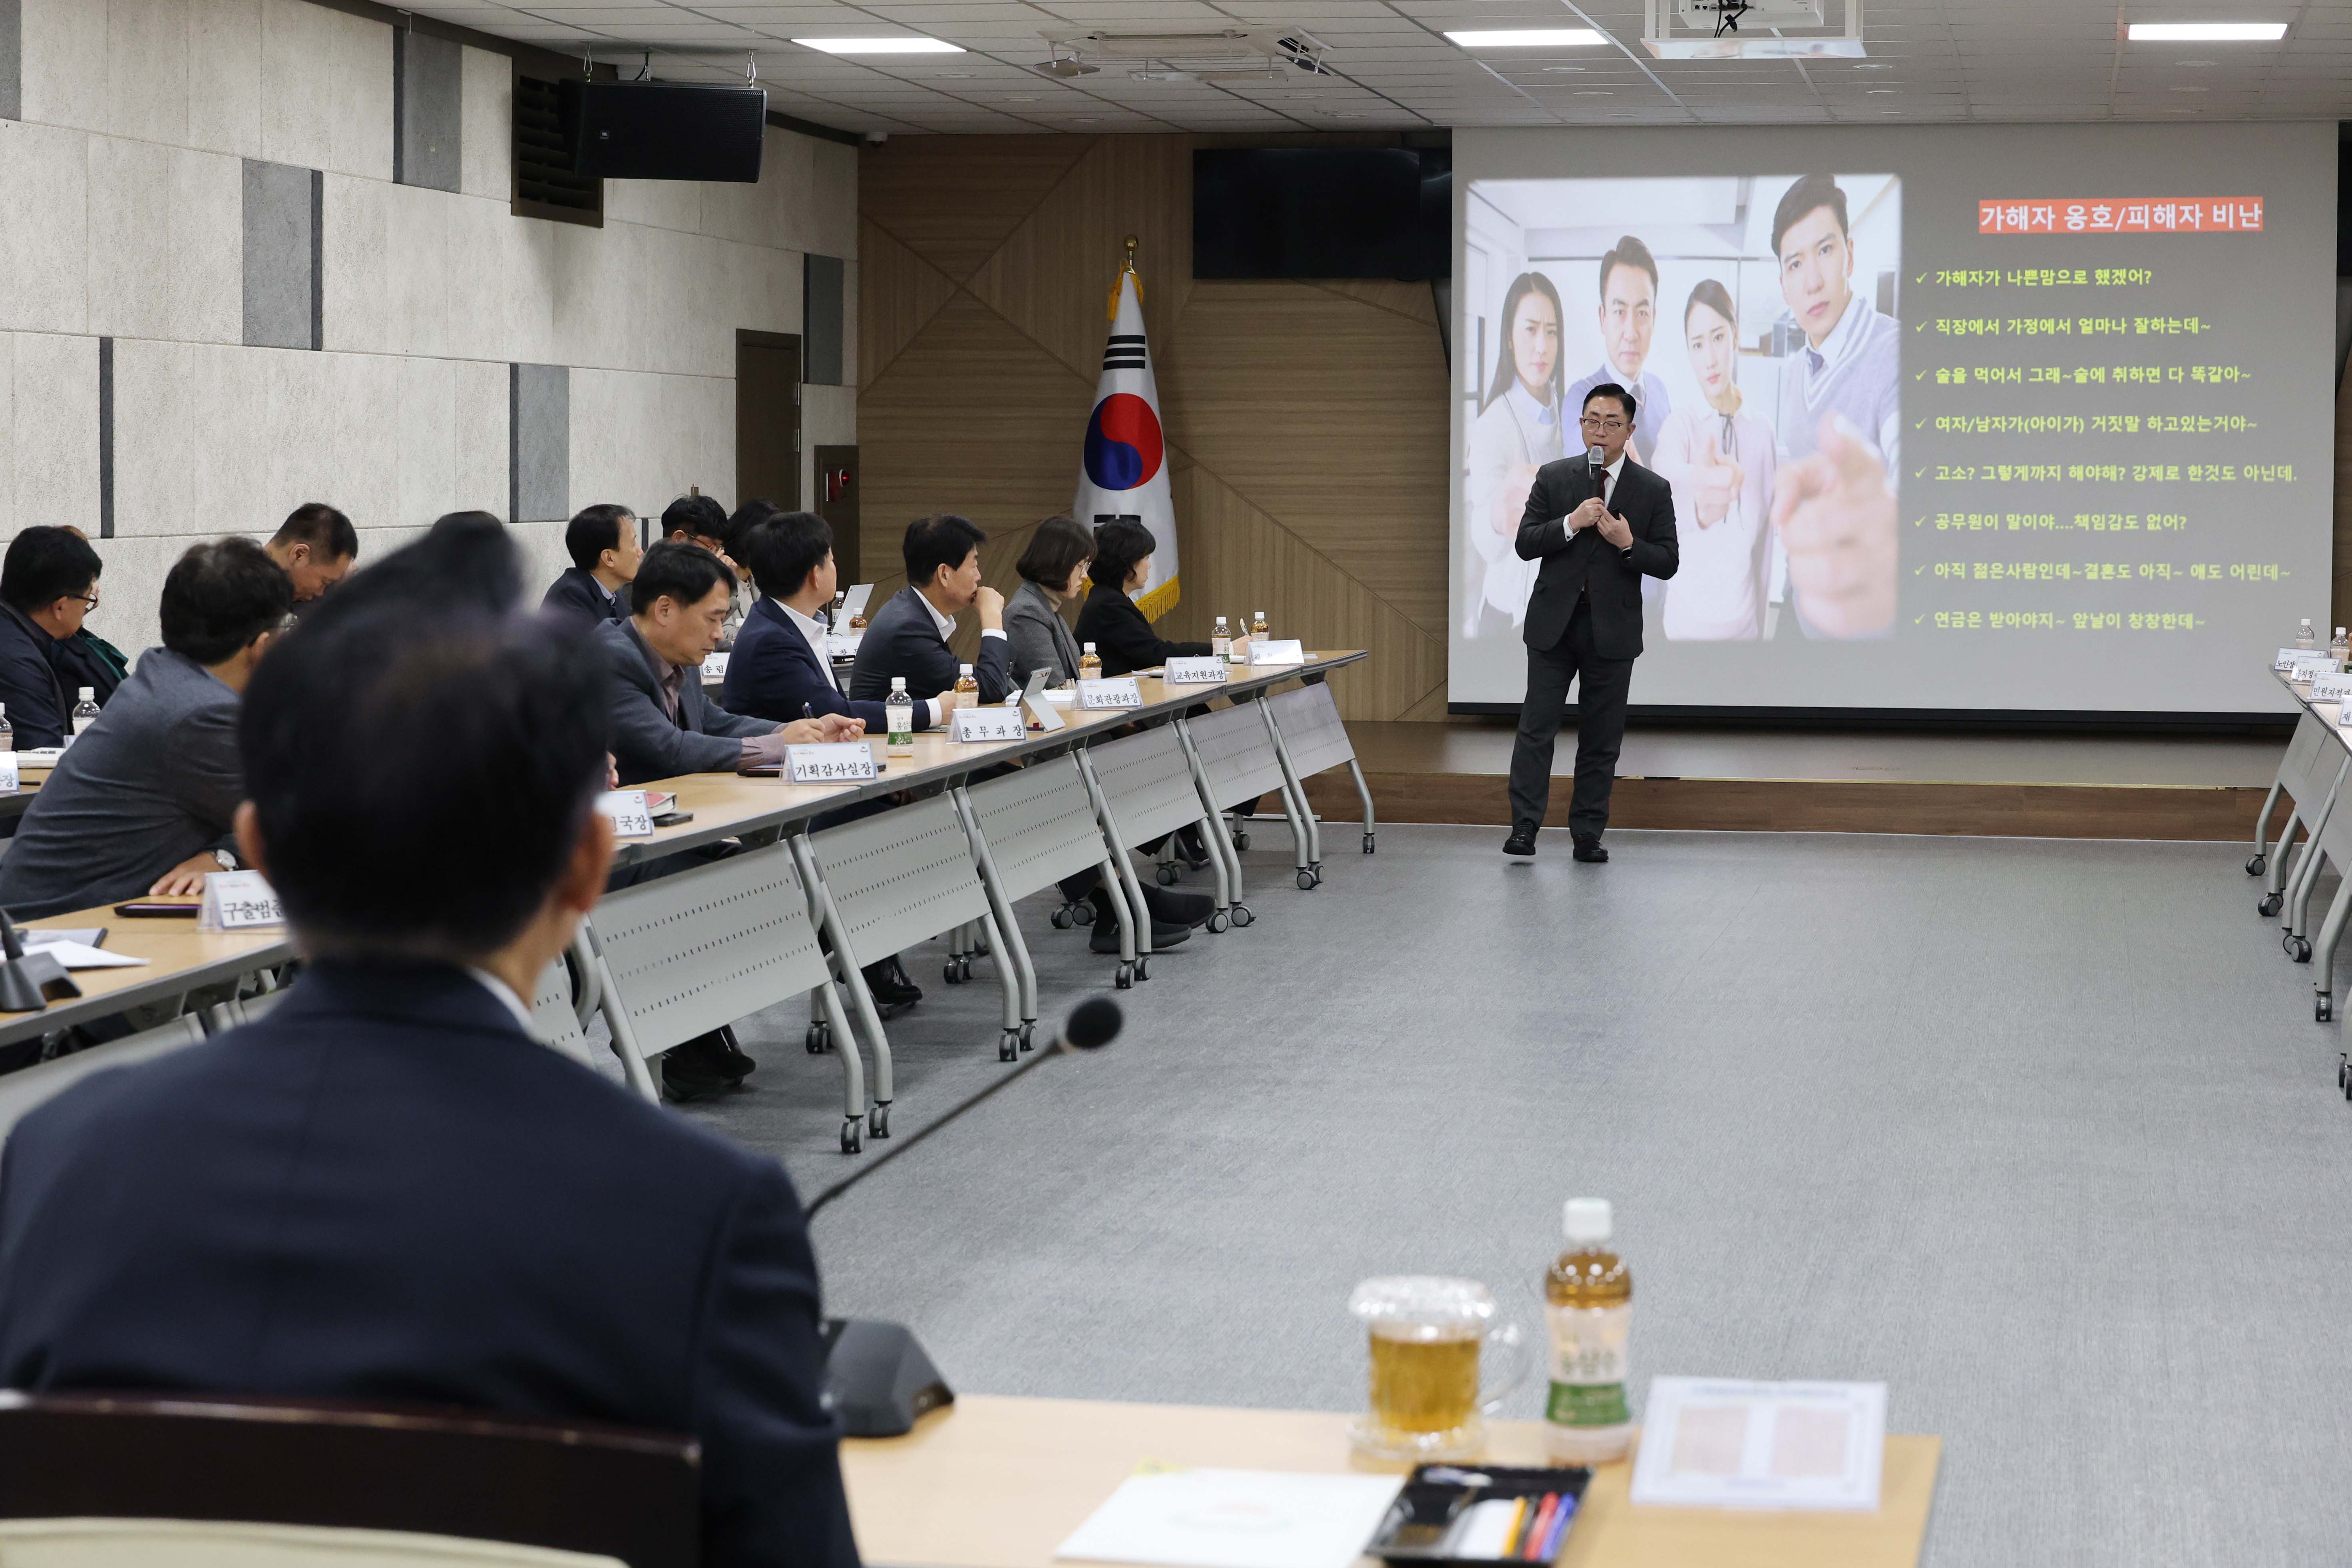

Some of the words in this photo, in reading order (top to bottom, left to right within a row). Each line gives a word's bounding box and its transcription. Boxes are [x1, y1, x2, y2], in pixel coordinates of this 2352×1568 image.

[1980, 205, 2056, 231] 가해자
[2063, 204, 2204, 230] 옹호/피해자
[2213, 203, 2262, 229] 비난
[1935, 269, 2002, 287] 가해자가
[2007, 268, 2089, 287] 나쁜맘으로
[2094, 268, 2153, 286] 했겠어?
[1936, 318, 2000, 336] 직장에서
[2007, 317, 2072, 336] 가정에서
[2078, 317, 2128, 335] 얼마나
[2133, 316, 2211, 334] 잘하는데~
[1935, 366, 1968, 384] 술을
[1974, 366, 2022, 384] 먹어서
[2112, 366, 2161, 384] 취하면
[2168, 366, 2185, 383] 다
[2191, 366, 2251, 384] 똑같아~
[1935, 415, 2085, 434] 여자/남자가(아이가)
[2091, 415, 2141, 432] 거짓말
[2148, 415, 2257, 432] 하고있는거야~
[1935, 465, 1976, 481] 고소?
[1982, 464, 2061, 482] 그렇게까지
[2069, 465, 2126, 482] 해야해?
[2133, 465, 2180, 482] 강제로
[2188, 464, 2236, 482] 한것도
[2244, 465, 2297, 482] 아닌데.
[1935, 513, 1999, 531] 공무원이
[2147, 513, 2187, 531] 없어?
[1935, 562, 1966, 579] 아직
[2139, 563, 2183, 580] 아직~
[2190, 563, 2223, 580] 애도
[2230, 563, 2290, 581] 어린데~
[1935, 611, 1982, 628] 연금은
[1990, 612, 2065, 629] 받아야지~
[2073, 613, 2121, 629] 앞날이
[2129, 613, 2205, 629] 창창한데~
[1175, 670, 1224, 680] 교육지원과장
[1086, 693, 1138, 705] 문화관광과장
[796, 762, 872, 778] 기획감사실장
